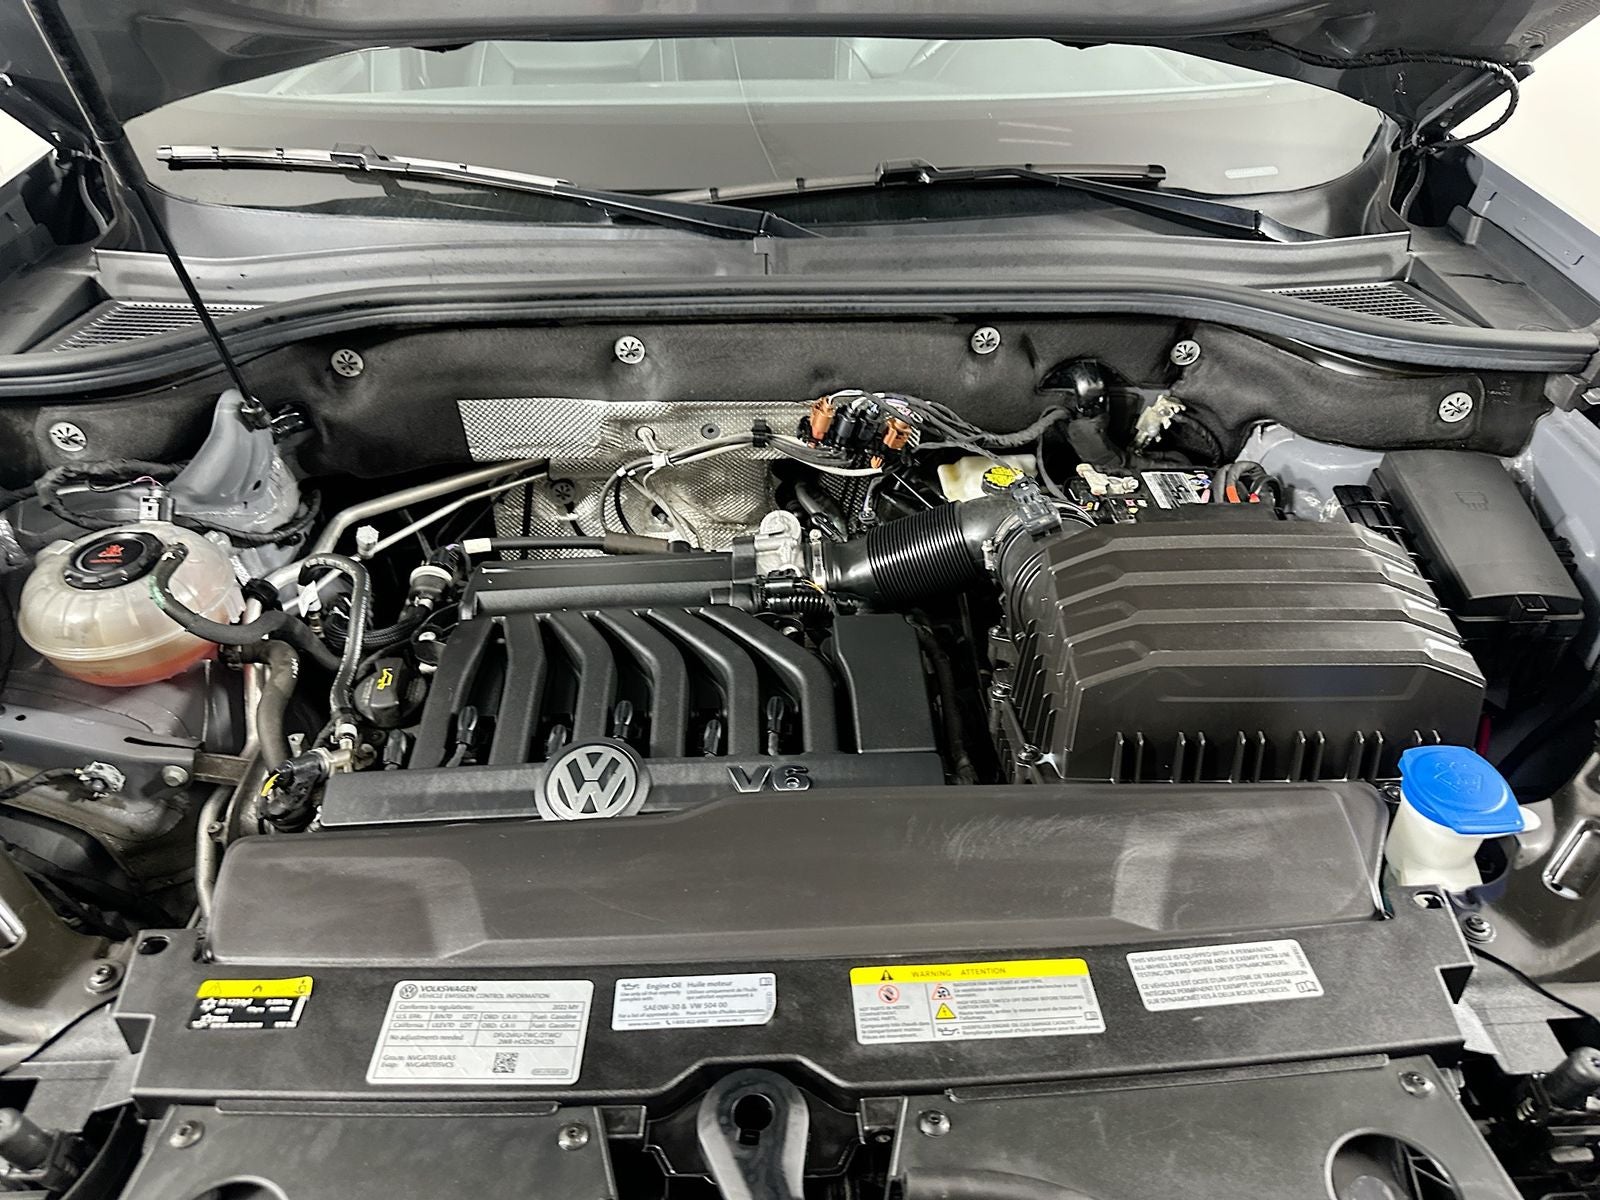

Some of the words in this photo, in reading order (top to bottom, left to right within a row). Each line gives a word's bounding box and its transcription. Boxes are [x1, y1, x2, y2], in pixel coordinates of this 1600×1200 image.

[727, 764, 812, 793] V6
[912, 970, 951, 978] WARNING
[960, 967, 1006, 975] ATTENTION
